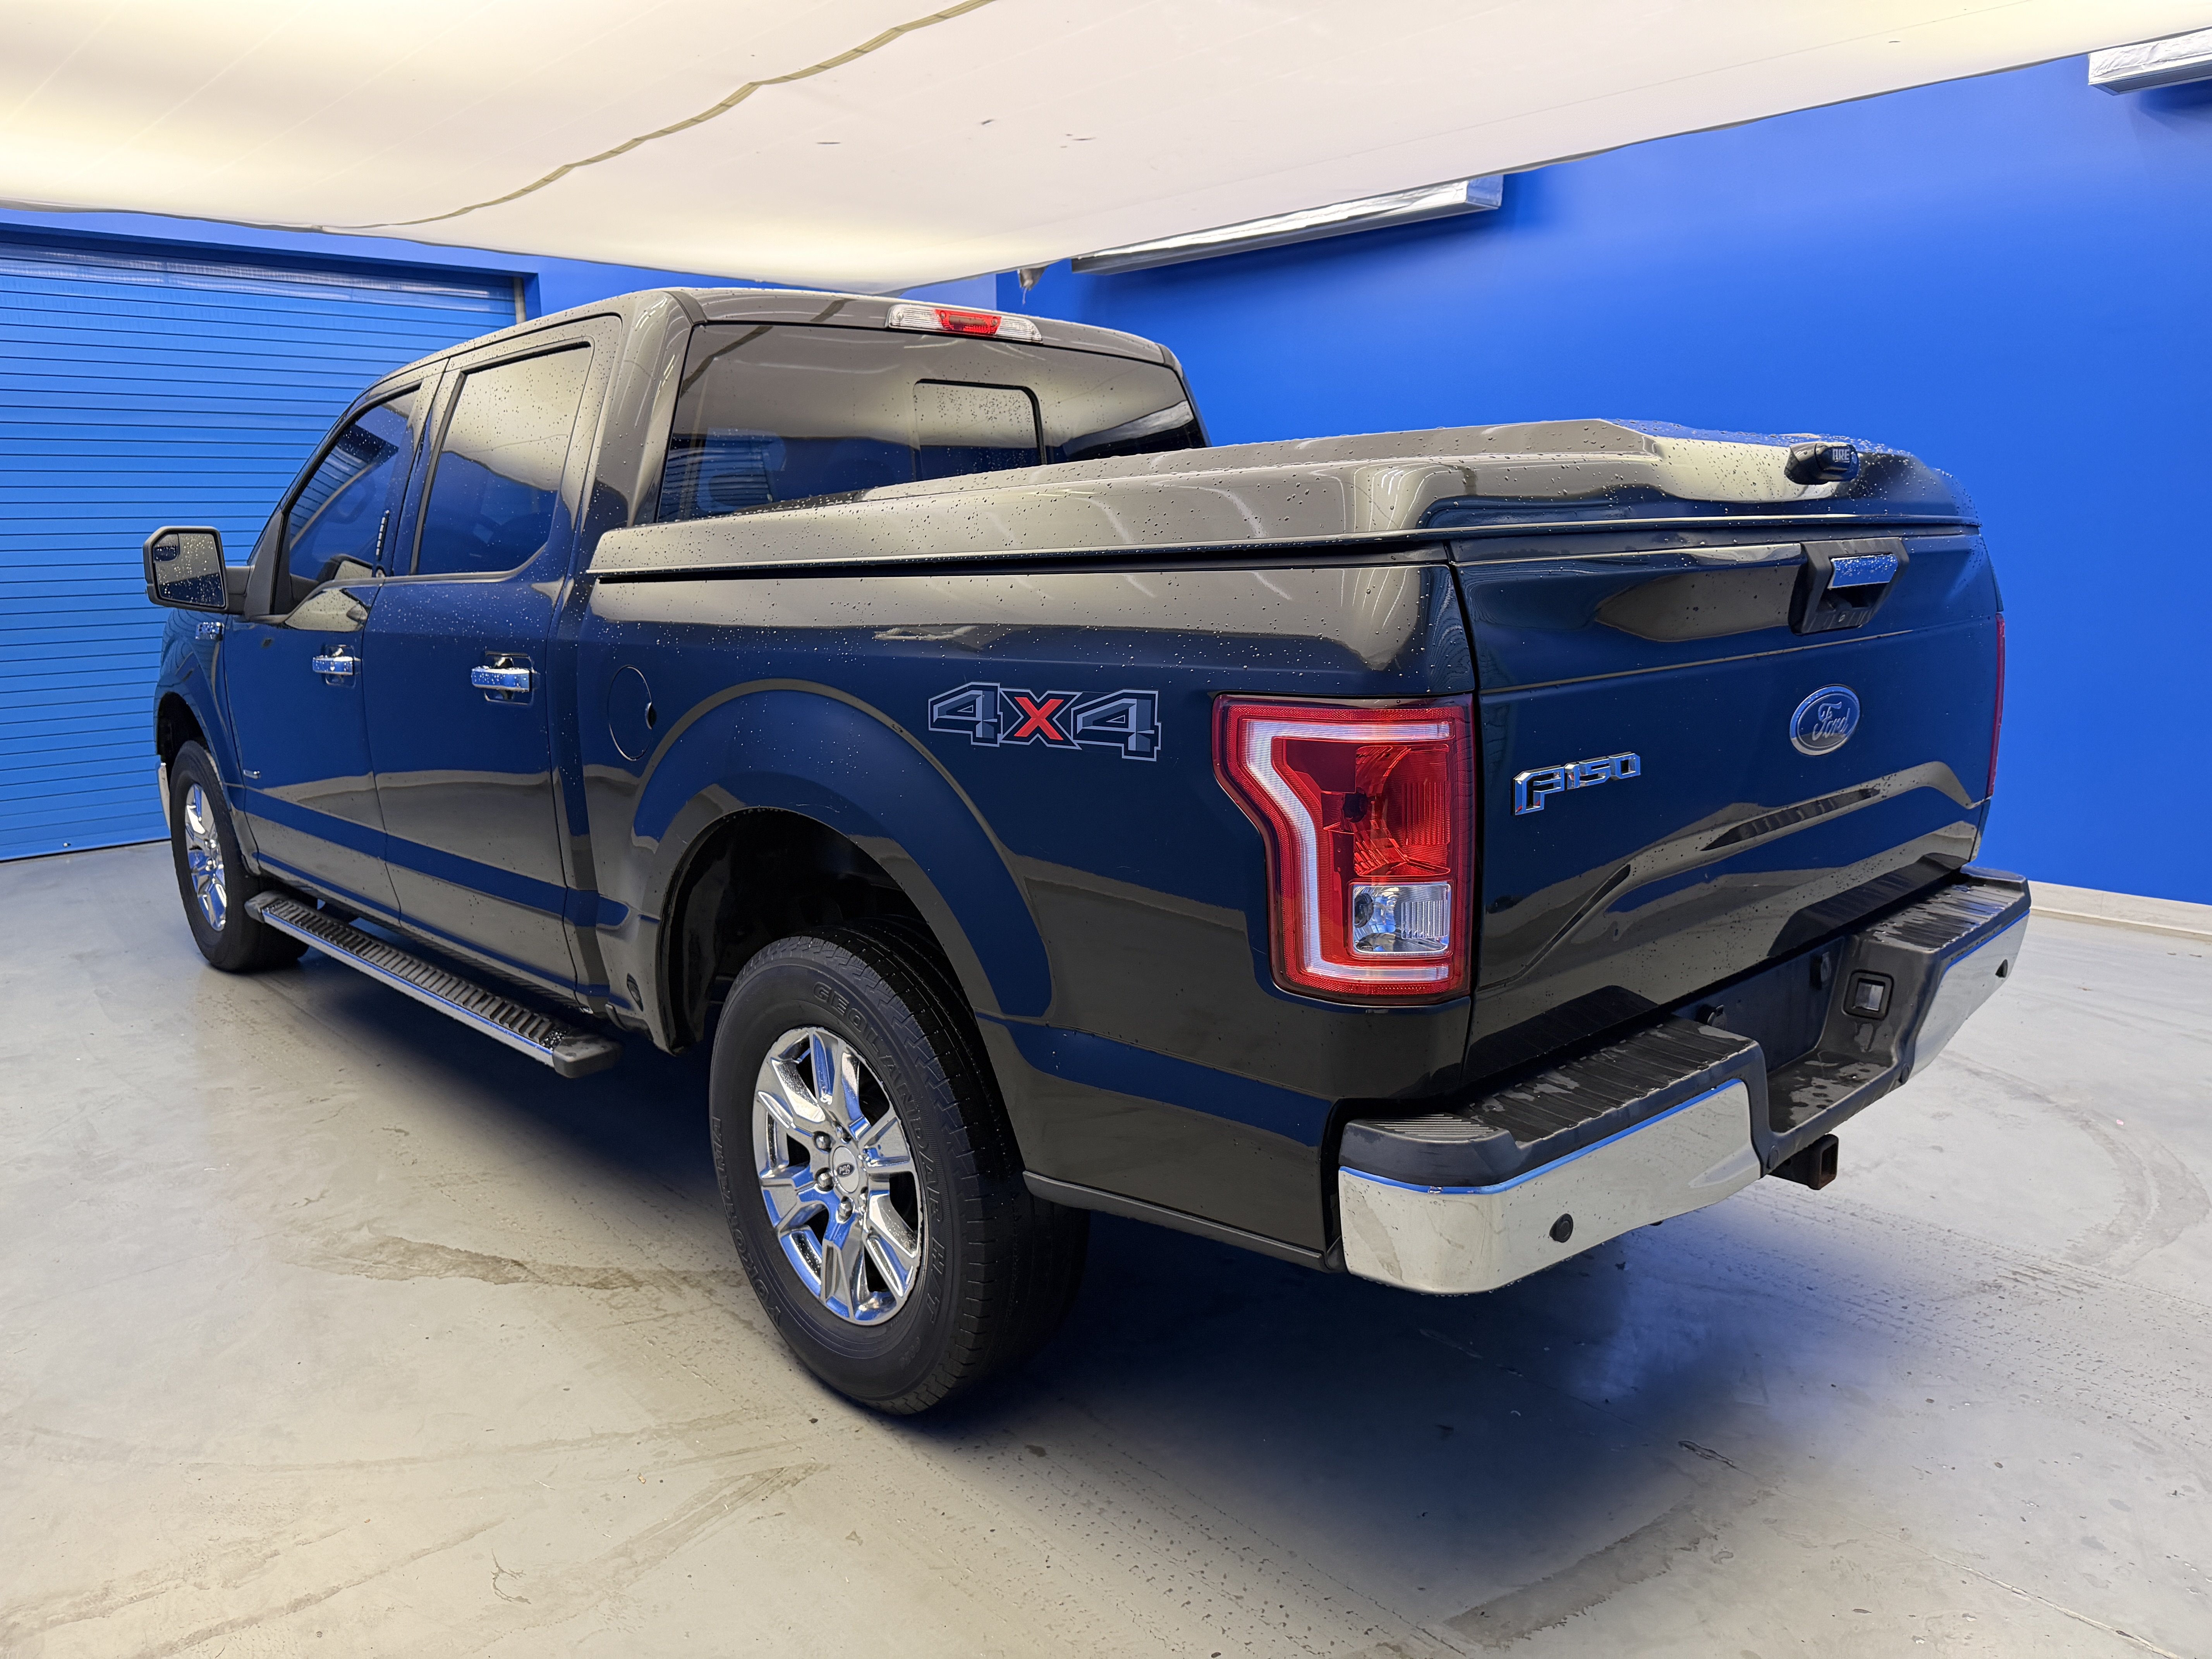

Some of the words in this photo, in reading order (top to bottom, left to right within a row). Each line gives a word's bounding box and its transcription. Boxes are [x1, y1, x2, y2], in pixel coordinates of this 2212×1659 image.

[1832, 448, 1850, 461] ARE
[1812, 701, 1850, 741] Ford
[813, 981, 943, 1222] GEOLANDAR
[712, 1116, 781, 1326] YOKOHAMA
